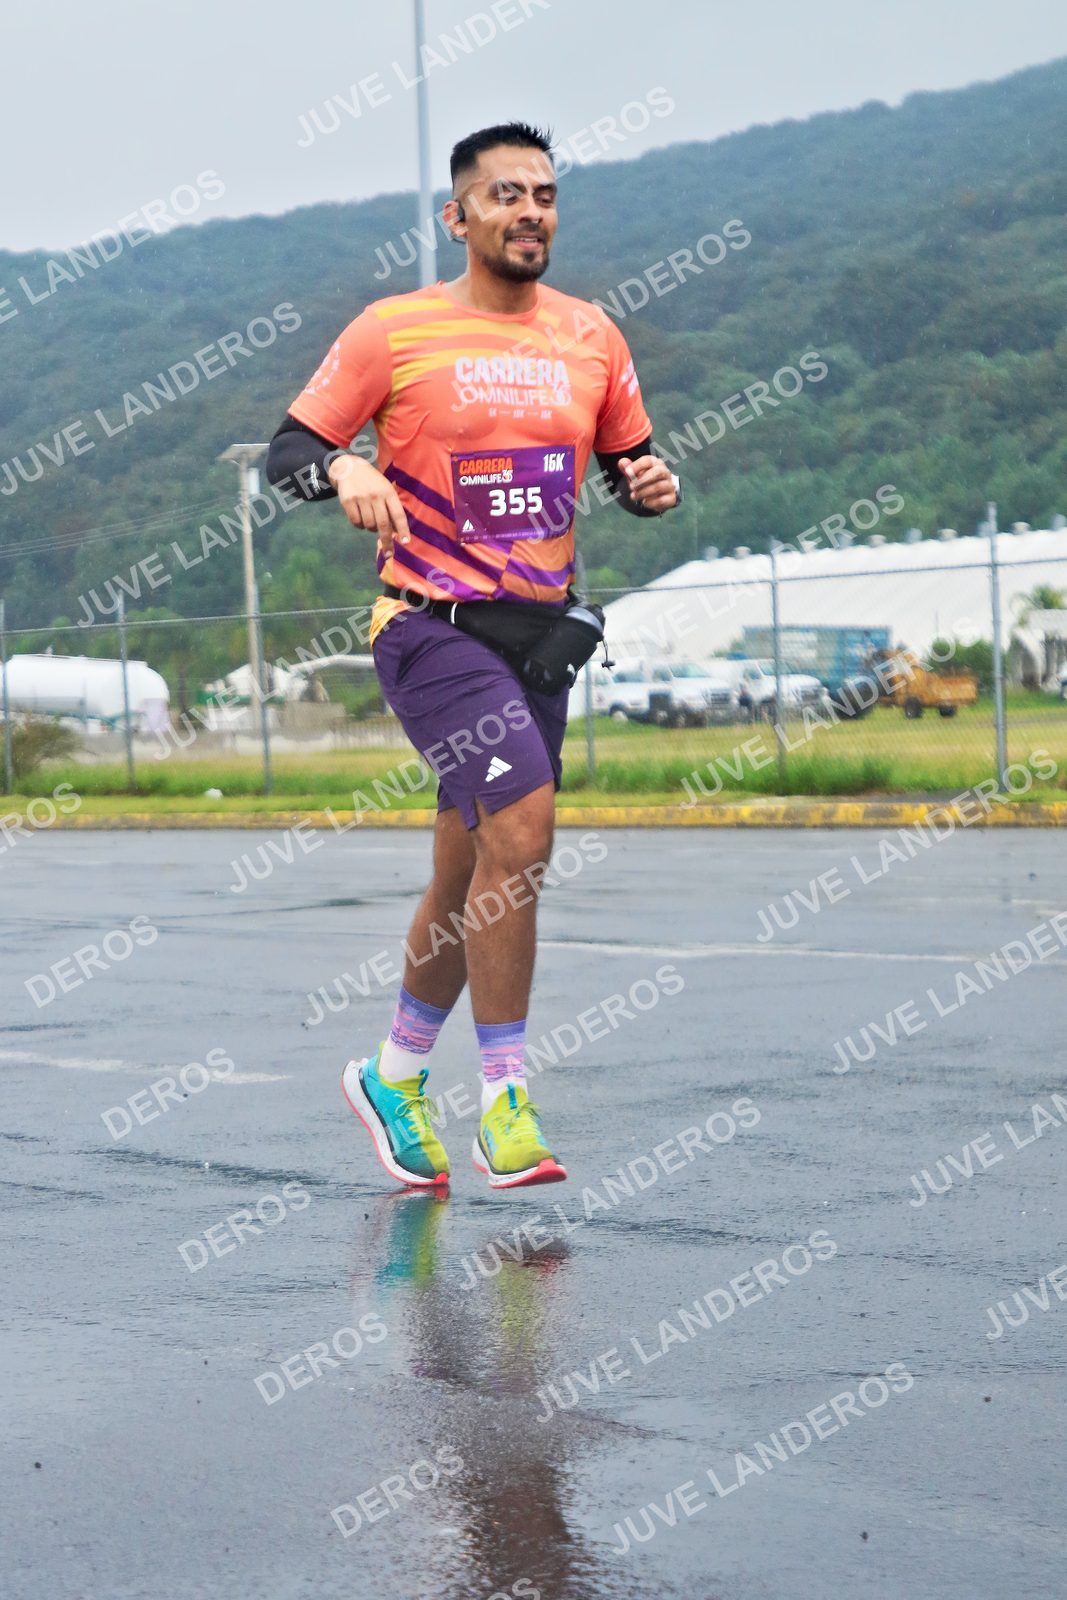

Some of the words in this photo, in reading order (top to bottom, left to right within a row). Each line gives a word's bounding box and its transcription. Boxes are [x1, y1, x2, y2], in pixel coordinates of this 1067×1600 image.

[455, 356, 570, 385] CARRERA
[459, 456, 513, 475] CARRERA
[488, 486, 543, 517] 355
